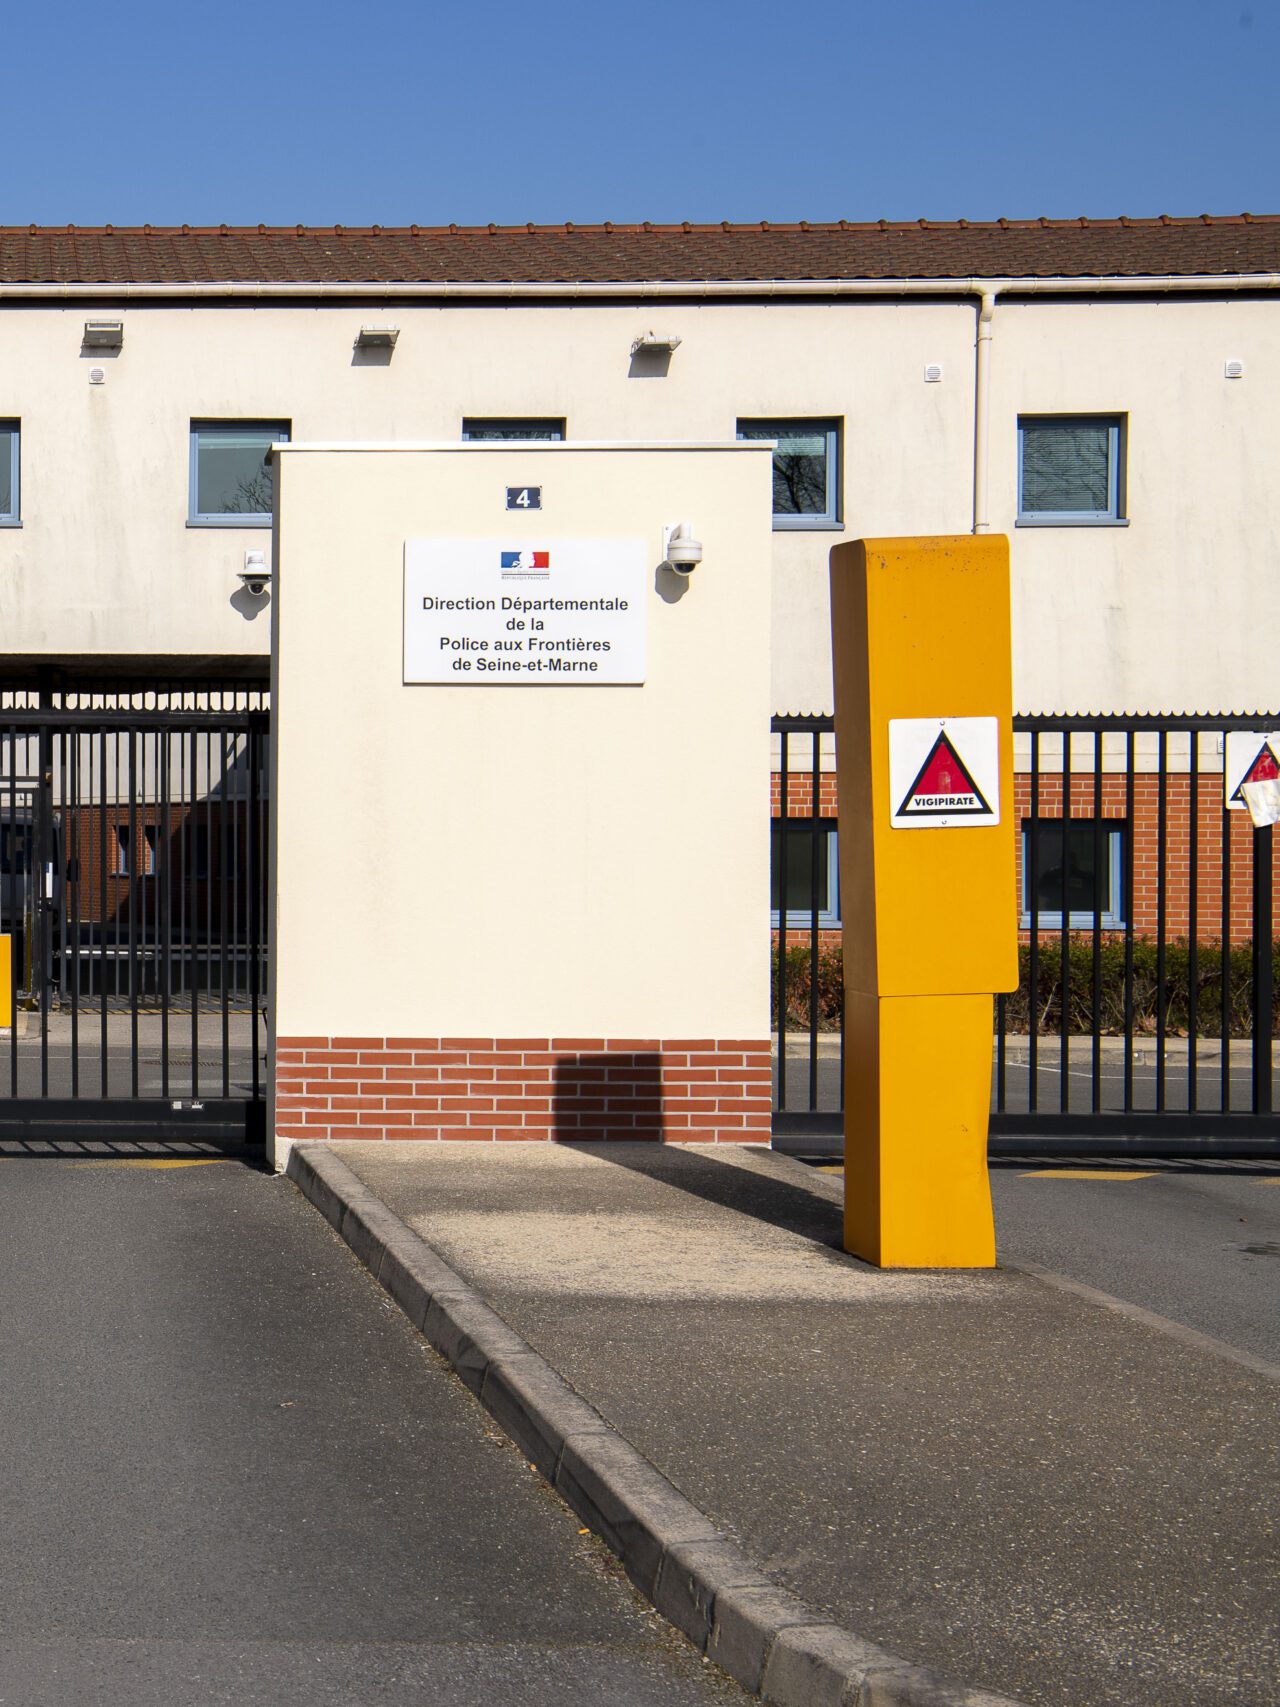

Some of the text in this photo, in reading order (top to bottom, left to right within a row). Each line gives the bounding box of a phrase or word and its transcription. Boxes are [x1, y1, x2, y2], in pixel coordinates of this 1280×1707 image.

[516, 489, 531, 508] 4
[422, 596, 629, 614] Direction Départementale
[505, 617, 545, 631] de la
[440, 636, 612, 652] Police aux Frontières
[452, 657, 598, 672] de Seine-et-Marne
[914, 797, 975, 807] VIGIPIRATE
